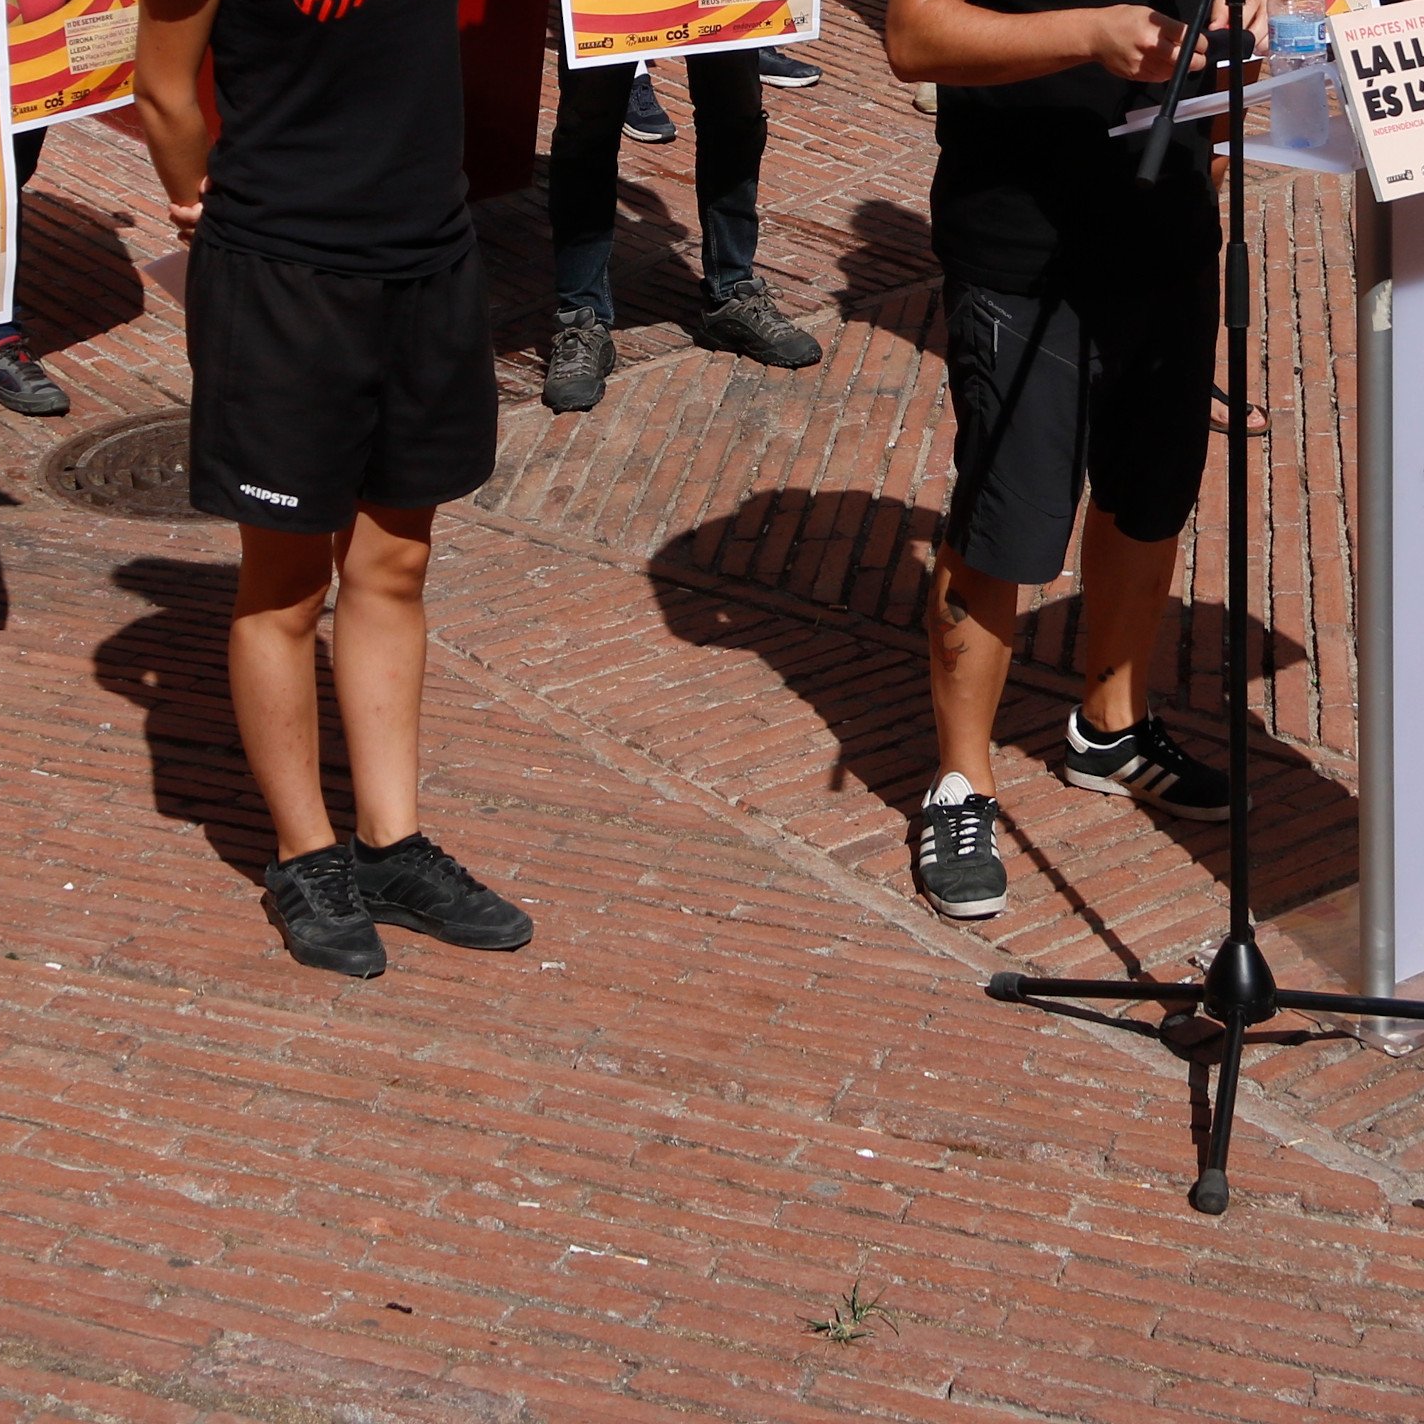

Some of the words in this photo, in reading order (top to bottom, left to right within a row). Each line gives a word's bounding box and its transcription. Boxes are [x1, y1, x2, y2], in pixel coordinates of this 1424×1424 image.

[1345, 29, 1359, 42] NI
[1359, 21, 1405, 39] PACTES,
[1405, 18, 1418, 30] NI
[1350, 44, 1396, 80] LA
[1362, 78, 1404, 122] ÉS
[244, 484, 299, 507] KIPSTA
